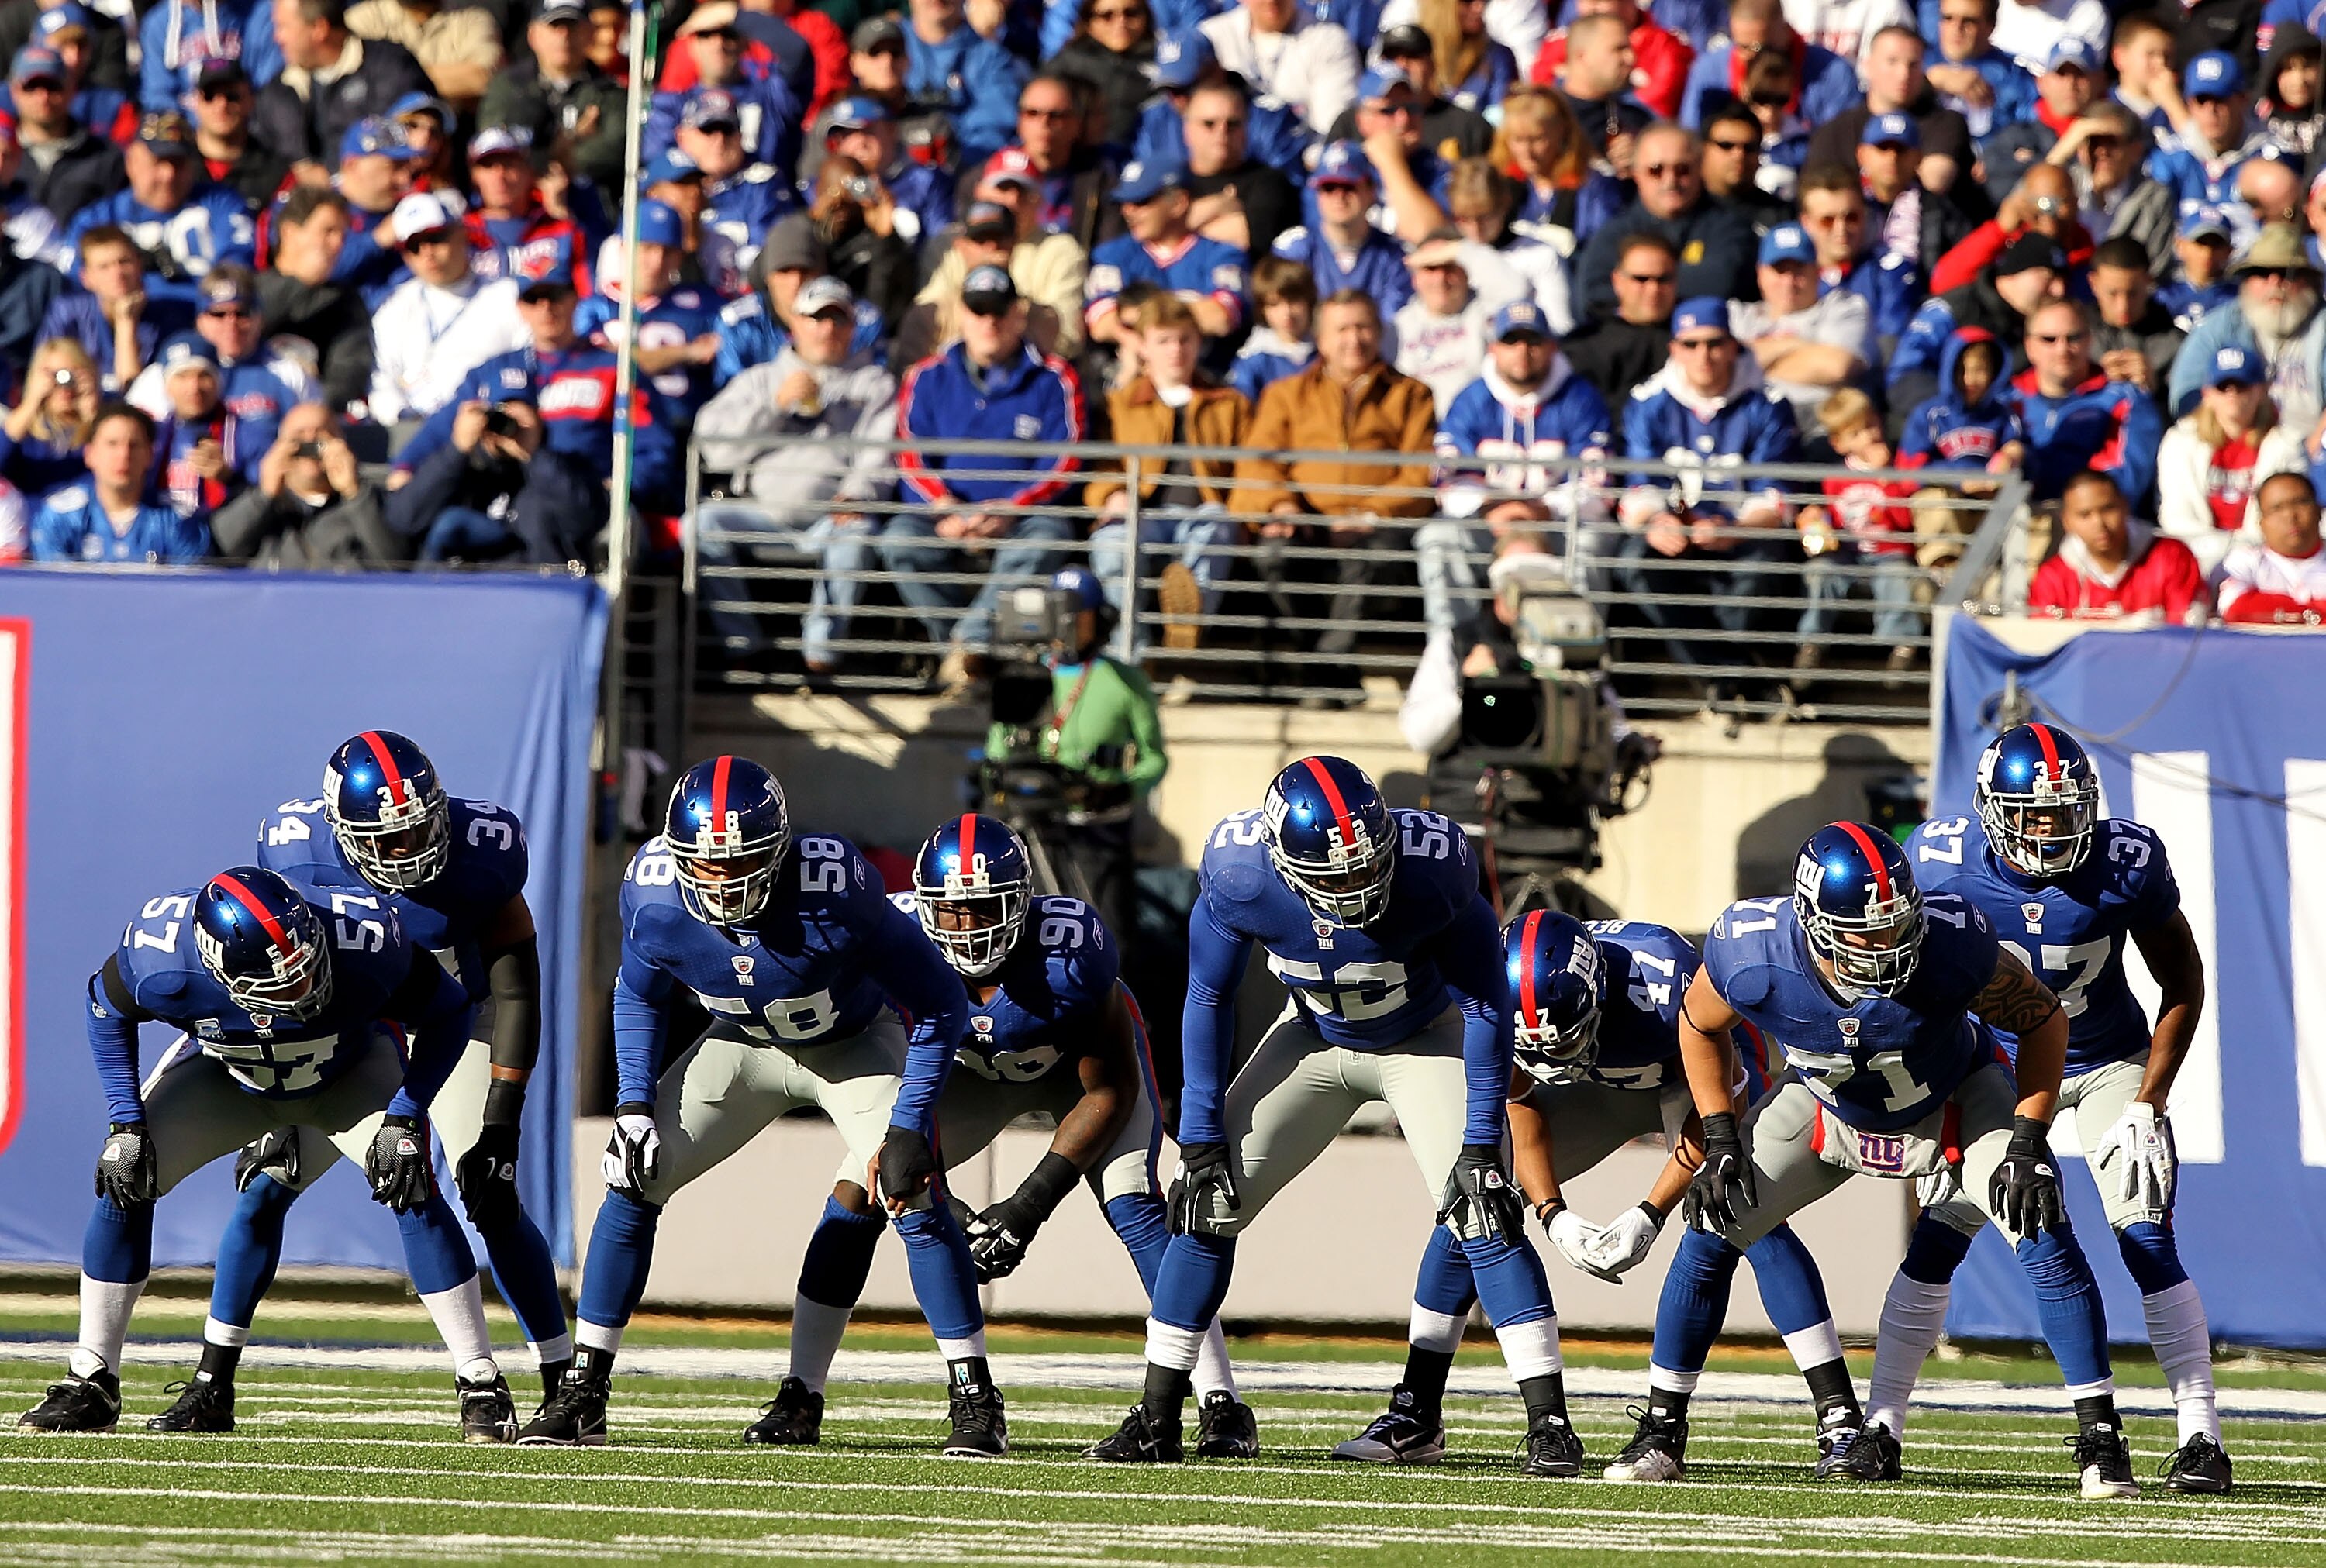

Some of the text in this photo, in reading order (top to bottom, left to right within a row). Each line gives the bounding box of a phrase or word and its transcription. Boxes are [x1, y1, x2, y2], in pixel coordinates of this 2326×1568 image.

[377, 777, 416, 808] 34
[2033, 760, 2070, 781] 37
[268, 798, 326, 846] 34
[466, 800, 512, 851] 34
[699, 811, 739, 832] 58
[1327, 819, 1366, 848] 52
[1401, 812, 1449, 860] 52
[1918, 816, 1969, 866] 37
[2108, 819, 2151, 868] 37
[800, 837, 847, 892] 58
[947, 853, 987, 874] 90
[1864, 877, 1899, 905] 71
[133, 895, 192, 953] 57
[330, 893, 385, 953] 57
[1039, 898, 1085, 949] 90
[1731, 897, 1789, 939] 71
[266, 928, 300, 963] 57
[1627, 950, 1675, 1011] 47
[1998, 935, 2111, 1018] 7
[1783, 1043, 1932, 1113] 71
[1858, 1132, 1905, 1173] ny
